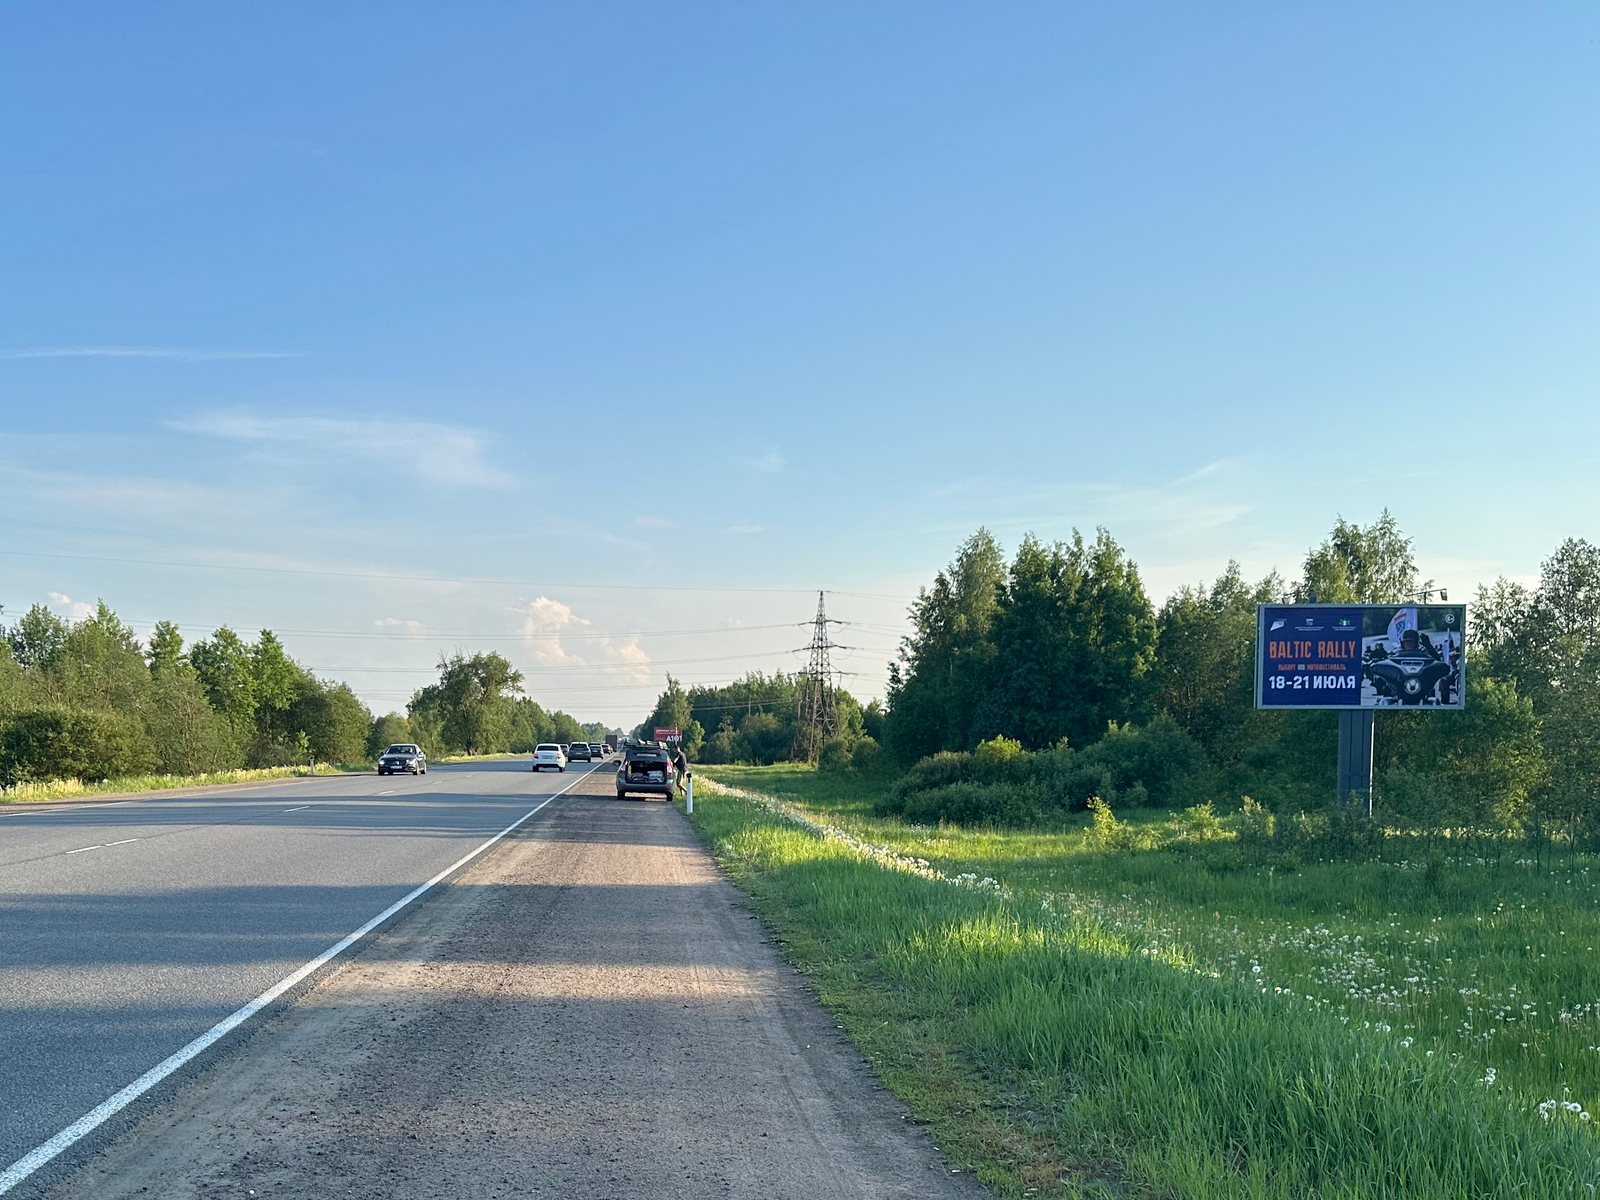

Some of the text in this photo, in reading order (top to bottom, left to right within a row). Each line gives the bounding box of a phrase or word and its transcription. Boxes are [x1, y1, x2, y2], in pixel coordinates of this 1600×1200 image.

[1269, 641, 1311, 658] BALTIC
[1269, 675, 1355, 689] 18-21 ИЮЛЯ
